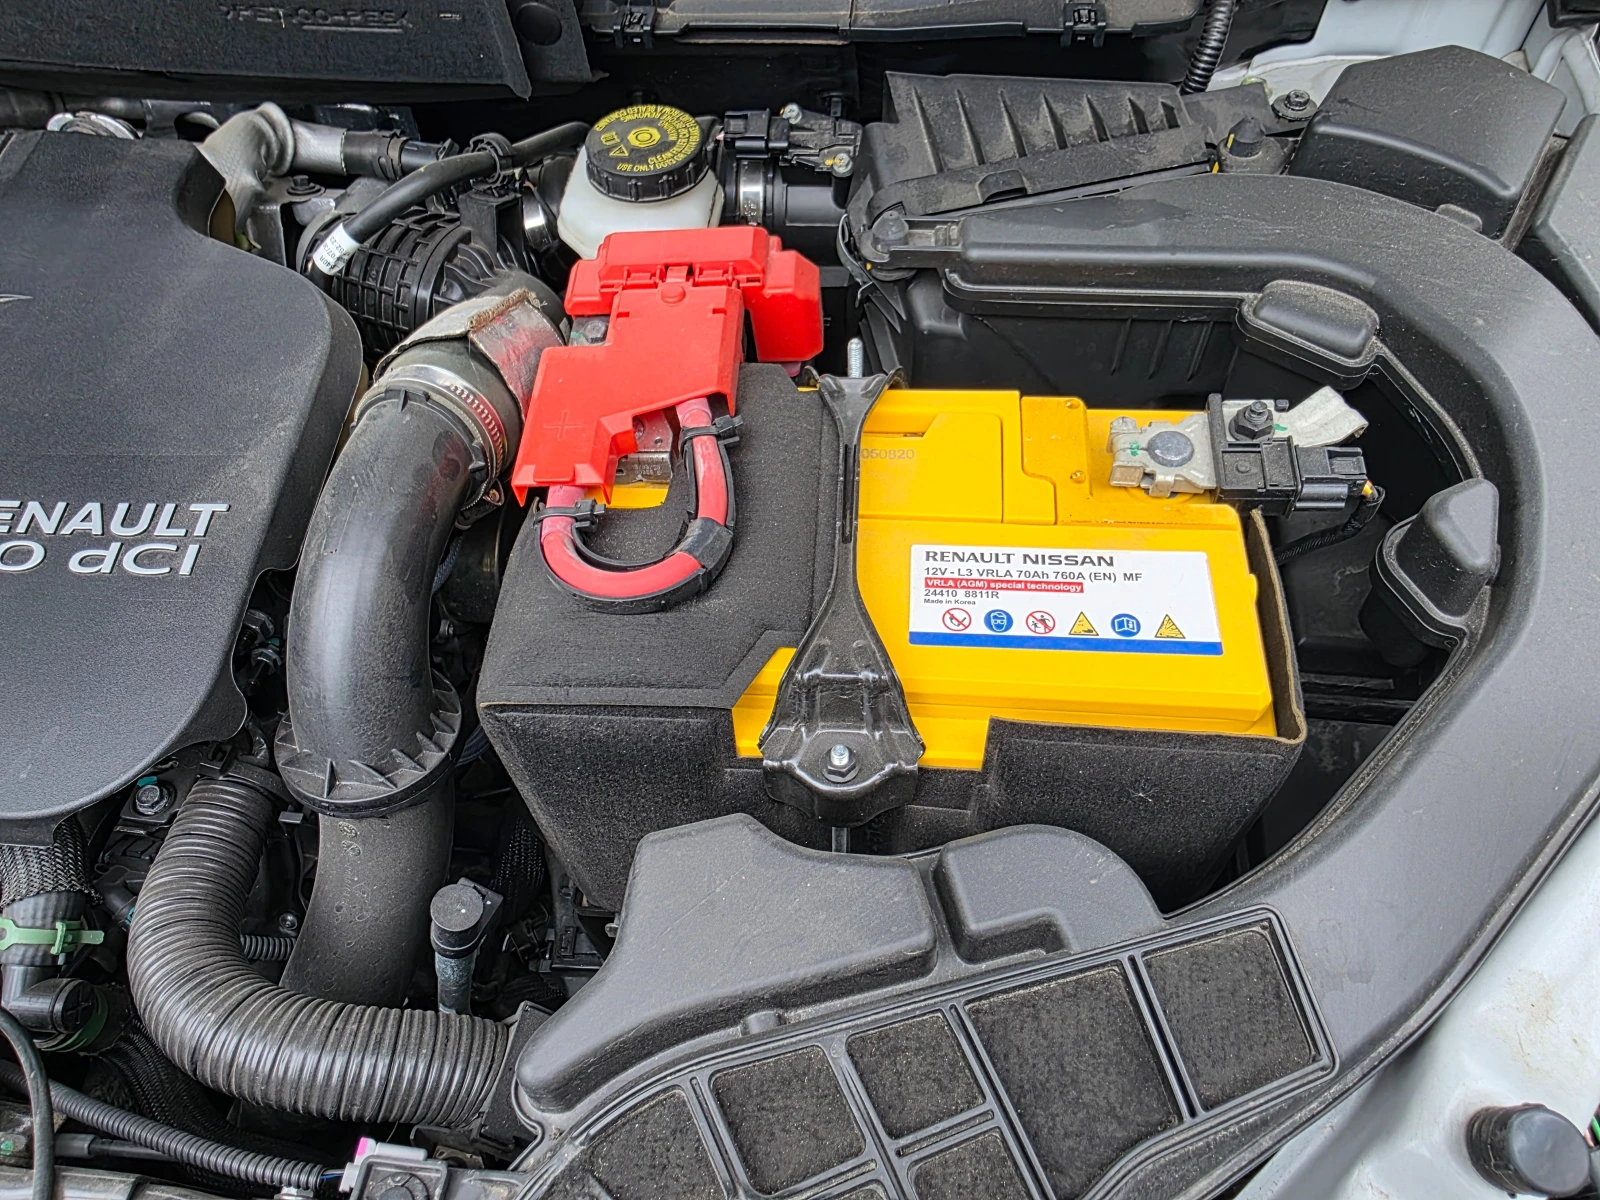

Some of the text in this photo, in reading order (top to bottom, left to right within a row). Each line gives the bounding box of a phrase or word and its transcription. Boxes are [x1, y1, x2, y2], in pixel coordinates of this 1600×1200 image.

[617, 163, 632, 172] USE
[634, 164, 654, 172] ONLY
[925, 551, 1114, 567] RENAULT NISSAN
[924, 567, 948, 576] 12V
[958, 568, 972, 577] L3
[977, 569, 1013, 578] VRLA
[1016, 570, 1049, 580] 70Ah
[1053, 571, 1086, 580] 760A
[1089, 572, 1117, 583] (EN)
[1123, 573, 1143, 582] MF
[926, 579, 1082, 593] VRLA (AGM) special technology
[924, 588, 1000, 599] 24410 8811R
